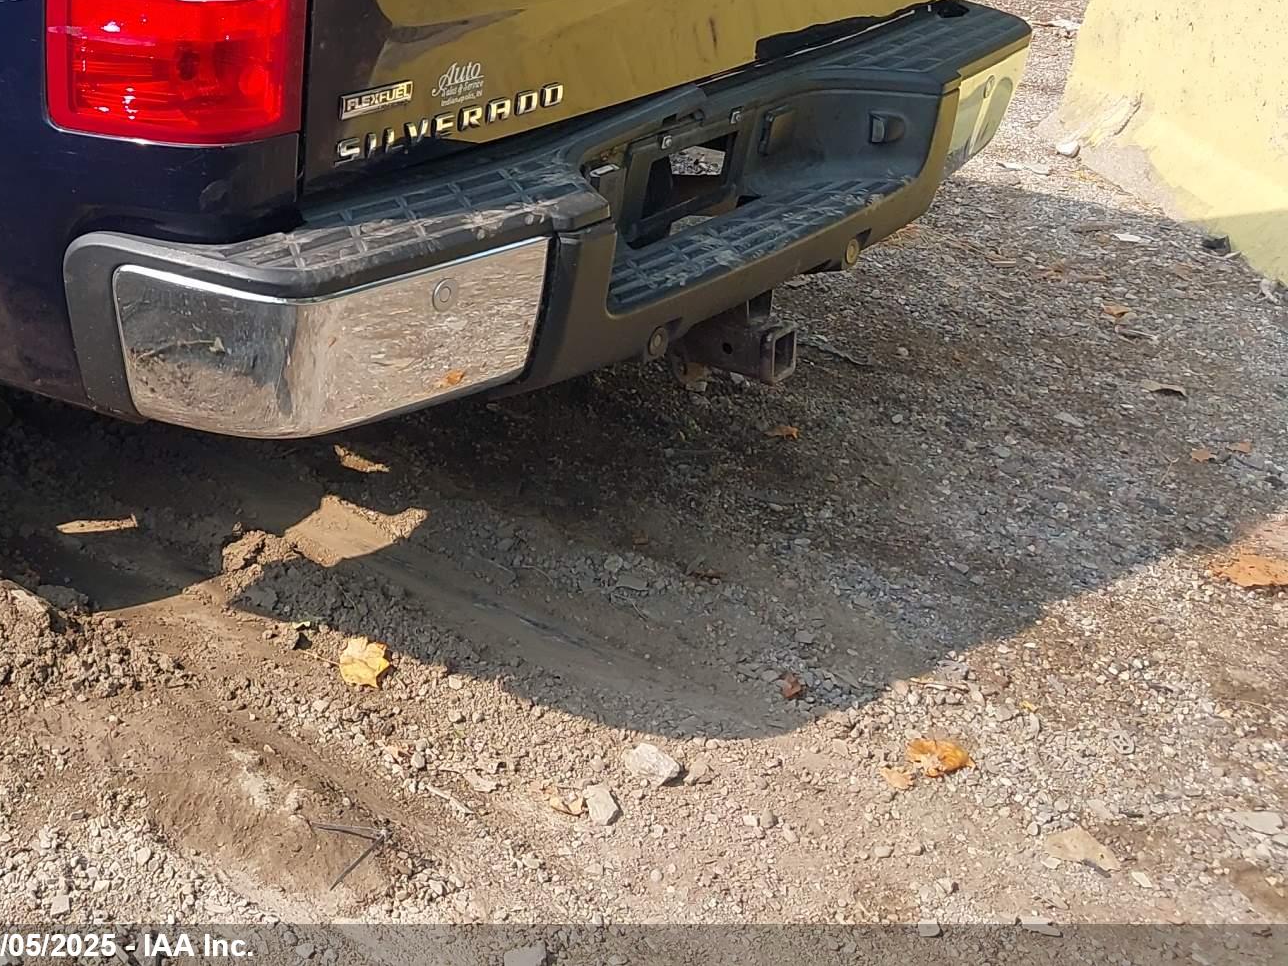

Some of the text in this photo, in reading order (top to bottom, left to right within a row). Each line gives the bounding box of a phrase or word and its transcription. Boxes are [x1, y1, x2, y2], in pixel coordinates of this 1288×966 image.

[431, 61, 484, 97] Auto
[345, 85, 411, 113] FLEXFUEL
[334, 82, 564, 168] SILVERADO
